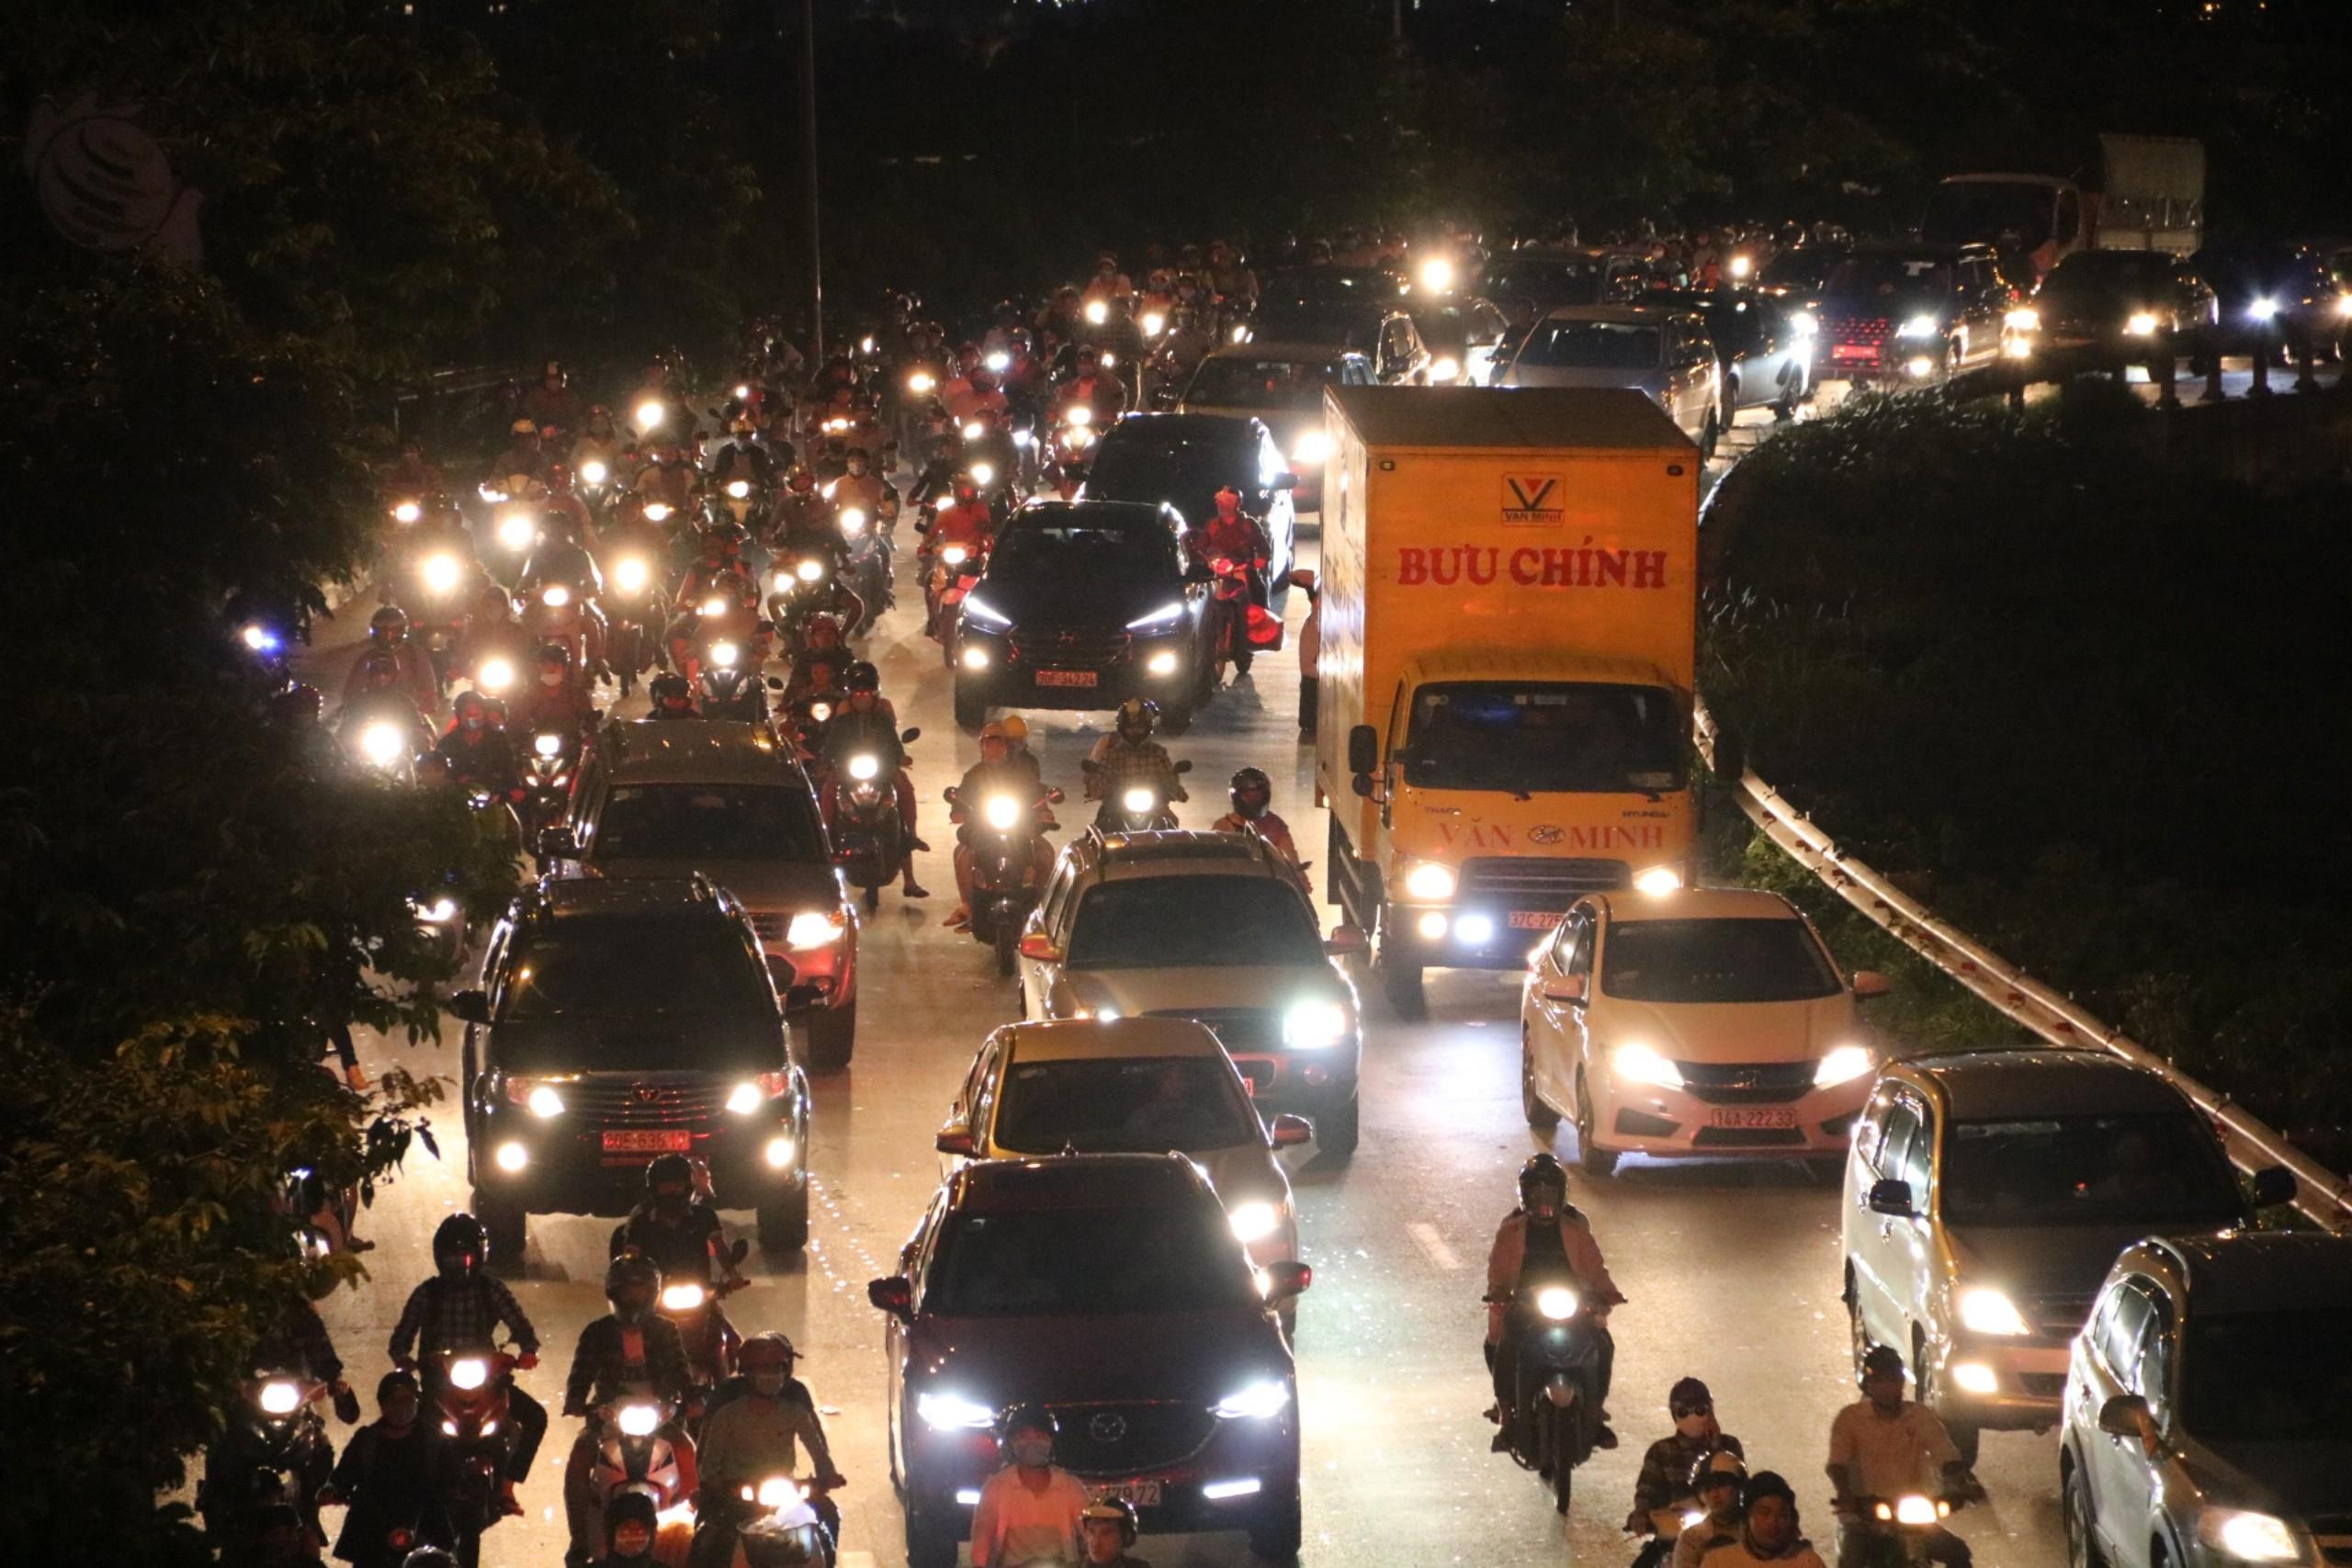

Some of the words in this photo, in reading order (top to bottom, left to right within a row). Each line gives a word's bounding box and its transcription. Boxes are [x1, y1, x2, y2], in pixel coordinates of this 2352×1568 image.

[1531, 512, 1562, 524] MINH
[1397, 543, 1499, 586] BƯU
[1509, 536, 1668, 589] CHÍNH
[1439, 817, 1511, 848] VĂN
[1569, 826, 1664, 850] MINH
[1510, 912, 1563, 928] 37C-275
